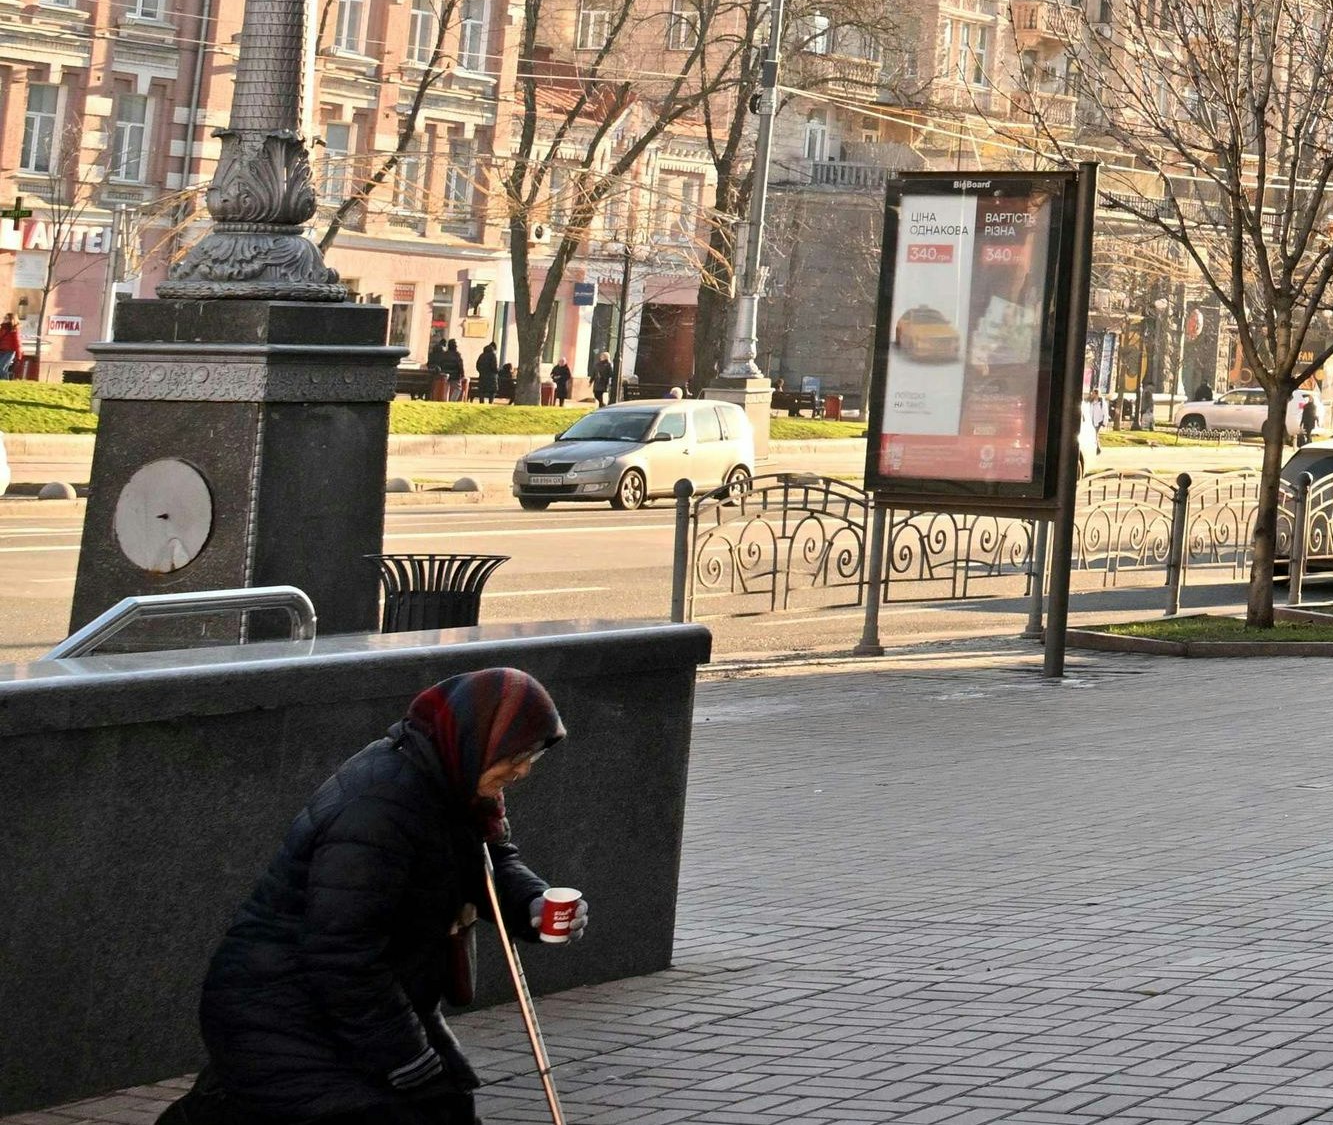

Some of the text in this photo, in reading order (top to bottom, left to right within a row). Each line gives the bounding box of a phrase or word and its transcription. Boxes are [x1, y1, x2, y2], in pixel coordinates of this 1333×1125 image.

[911, 212, 937, 223] ЦІНА
[985, 213, 1037, 224] ВАРТІСТЬ
[910, 225, 969, 236] ОДНАКОВА
[984, 225, 1016, 236] РІЗНА
[910, 247, 937, 261] 340
[984, 248, 1012, 262] 340
[49, 320, 80, 331] ОПТИКА
